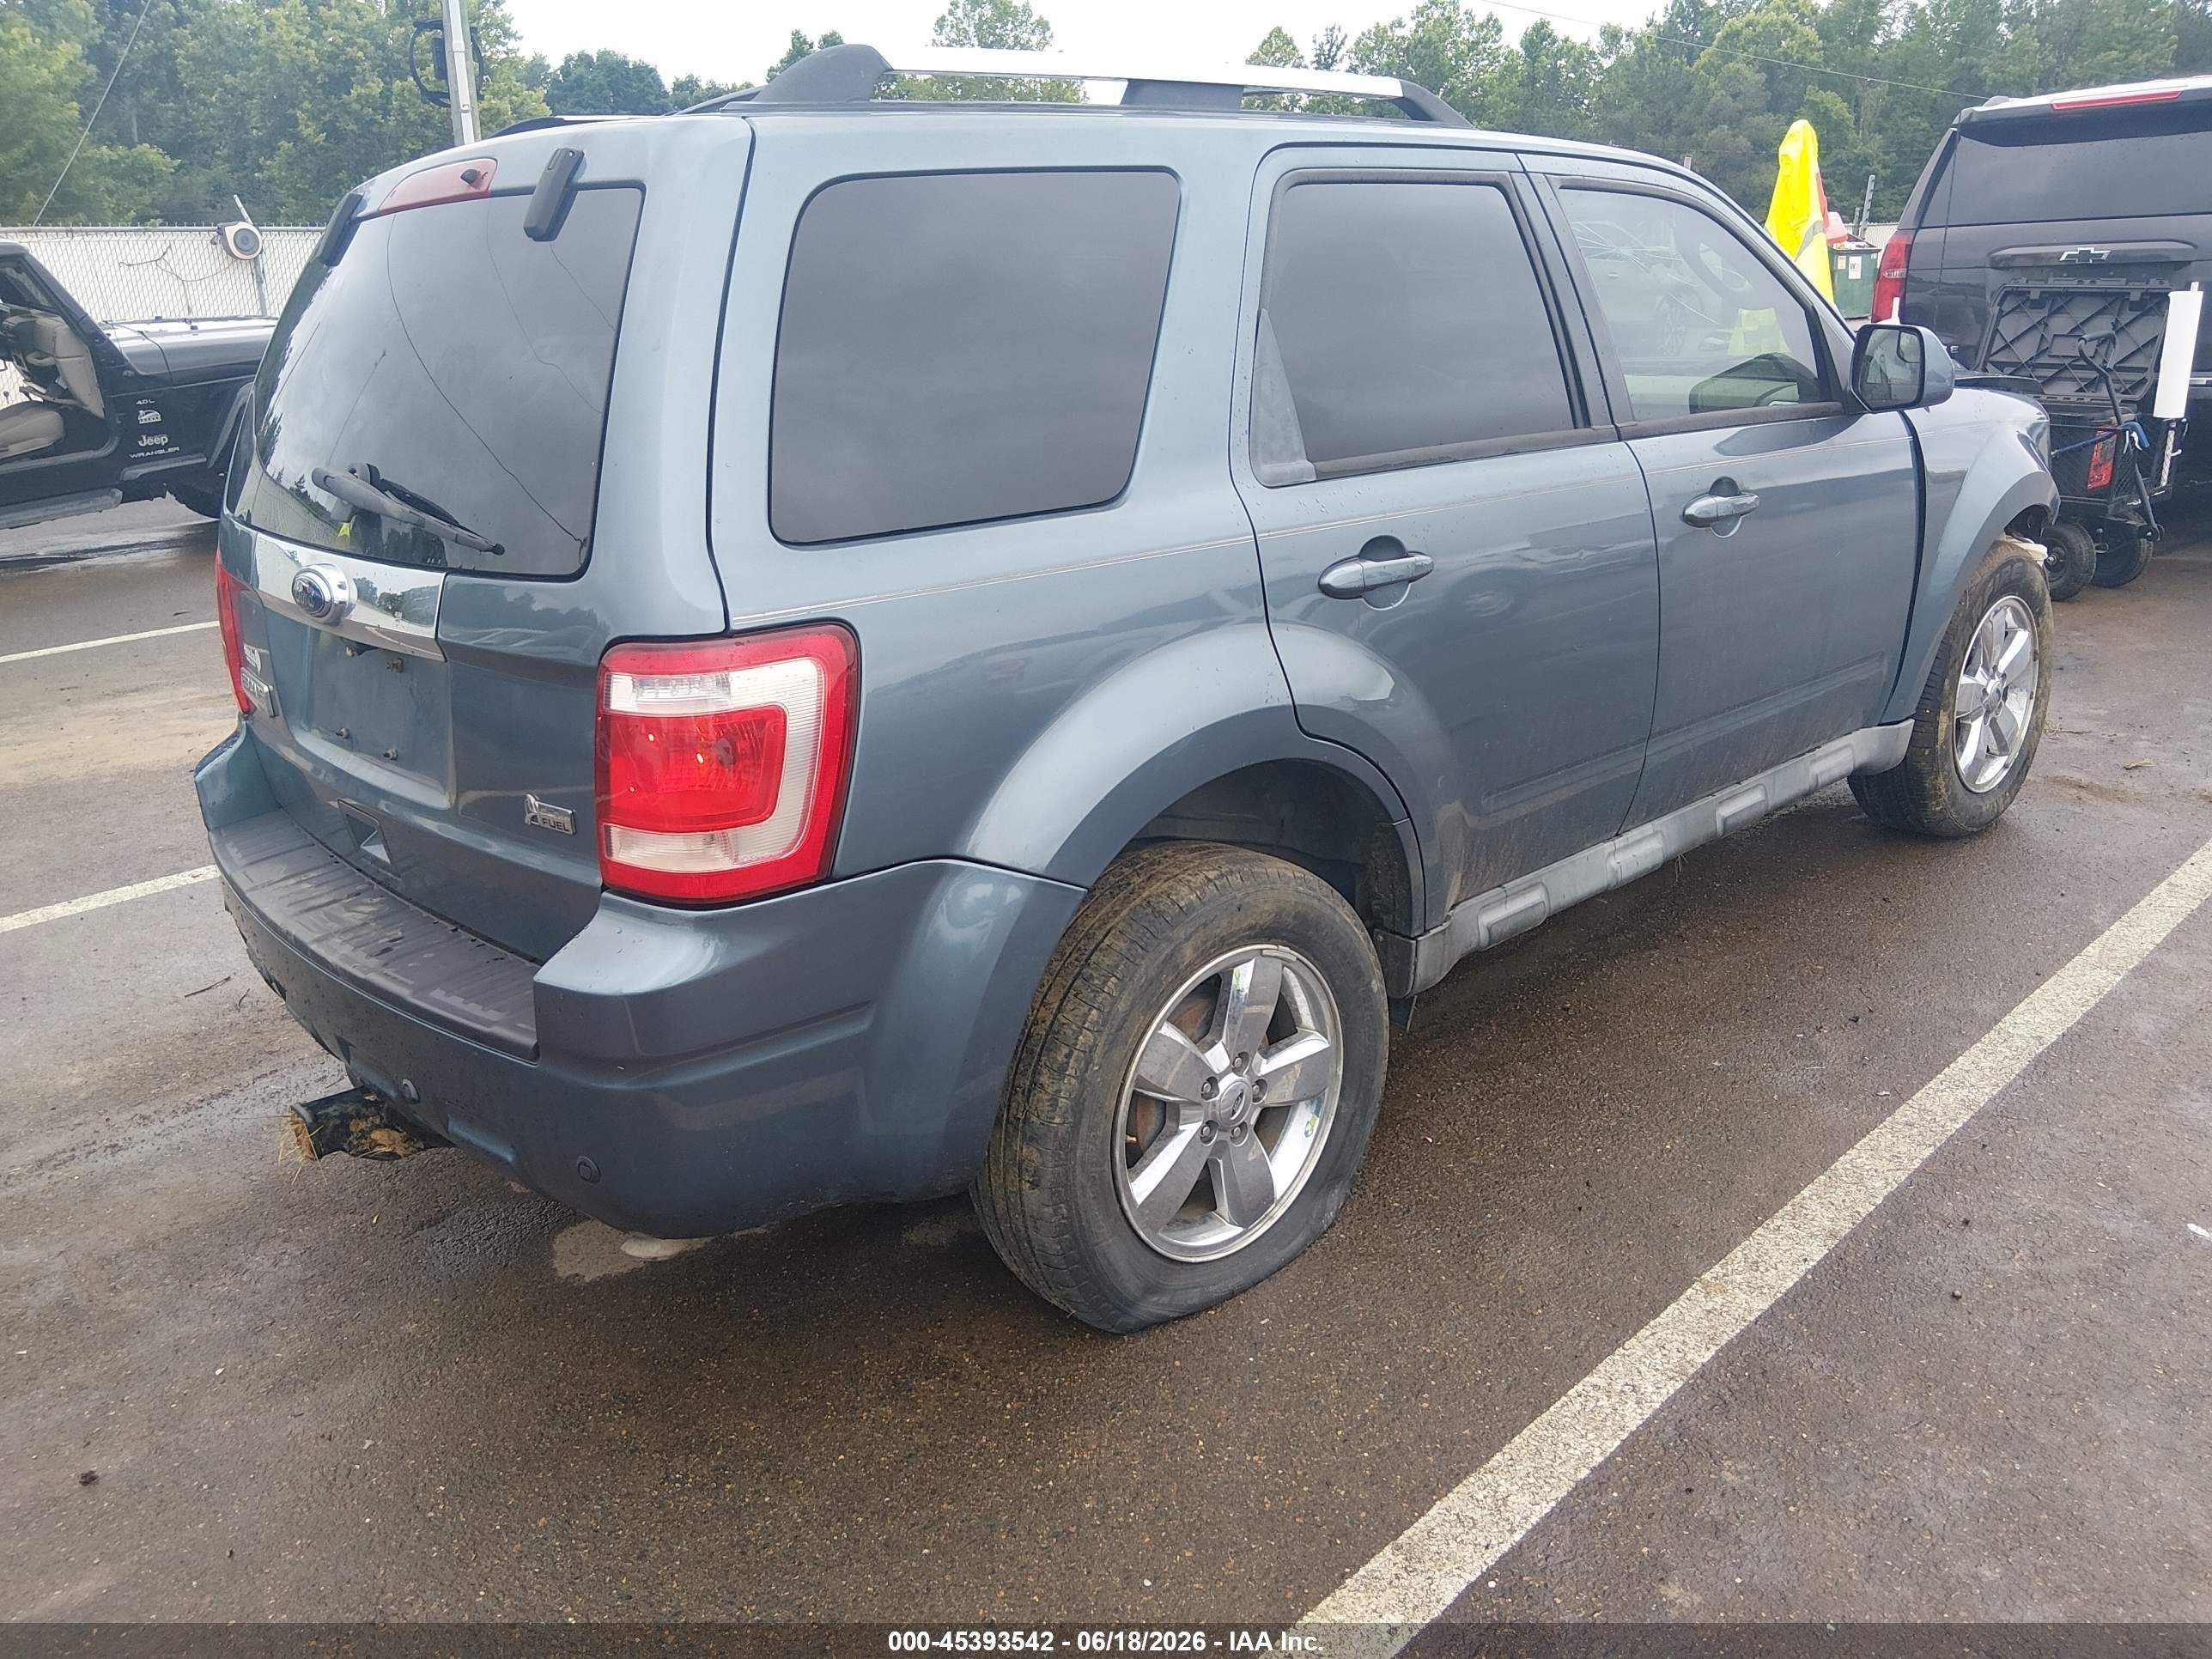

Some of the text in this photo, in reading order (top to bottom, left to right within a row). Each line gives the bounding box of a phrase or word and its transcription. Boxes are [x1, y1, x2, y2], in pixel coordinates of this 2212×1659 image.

[137, 434, 168, 447] Jeep
[129, 446, 180, 459] WRANGLER
[542, 817, 570, 832] FUEL
